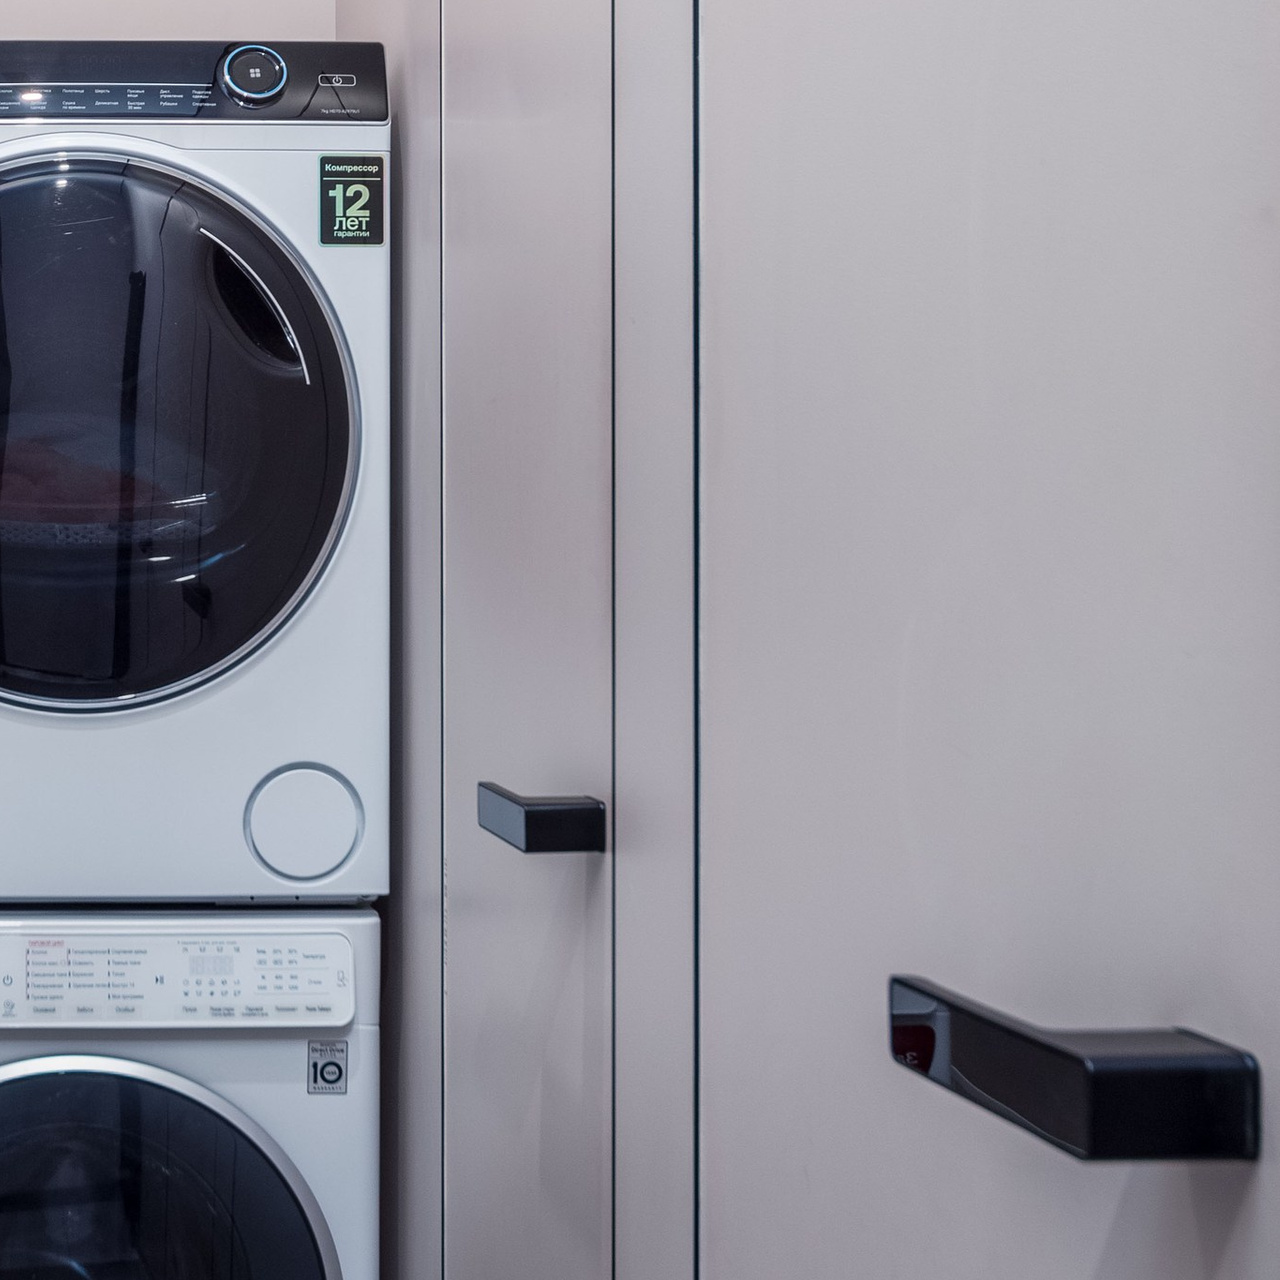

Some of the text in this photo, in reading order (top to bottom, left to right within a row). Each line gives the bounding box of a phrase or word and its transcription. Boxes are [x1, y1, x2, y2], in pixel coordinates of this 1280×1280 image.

[325, 163, 379, 173] Компрессор
[328, 183, 371, 217] 12
[333, 217, 371, 230] лет
[333, 230, 370, 238] гарантии
[312, 1061, 343, 1084] 10
